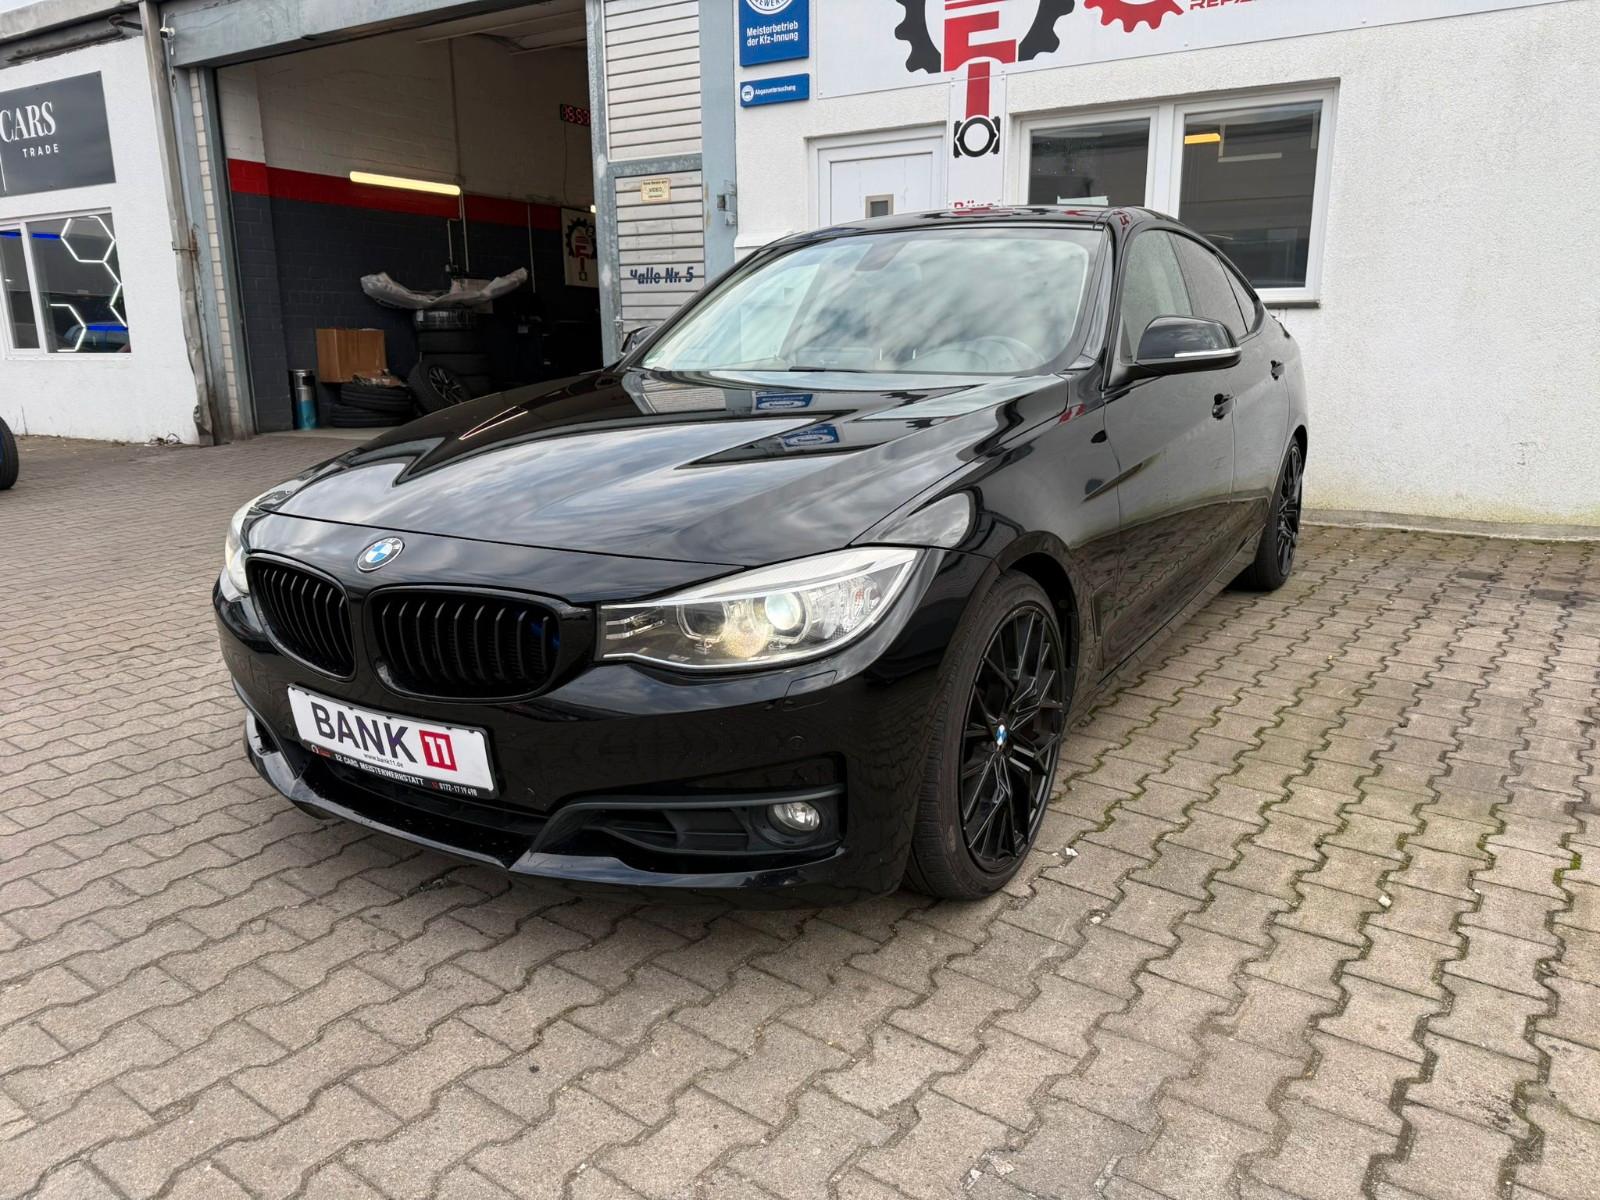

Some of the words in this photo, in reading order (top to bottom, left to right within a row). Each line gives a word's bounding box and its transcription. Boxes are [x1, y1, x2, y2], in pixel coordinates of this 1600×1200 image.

[746, 20, 799, 37] Meisterbetrieb
[746, 37, 759, 47] der
[759, 31, 799, 45] Kfz-Innung
[0, 101, 57, 143] CARS
[22, 143, 60, 159] TRADE
[664, 267, 682, 284] Nr.
[685, 266, 694, 283] 5
[311, 701, 418, 764] BANK
[422, 734, 454, 768] 11
[362, 753, 405, 769] www.bank11.de
[359, 762, 425, 787] MEISTERWERKSTATT
